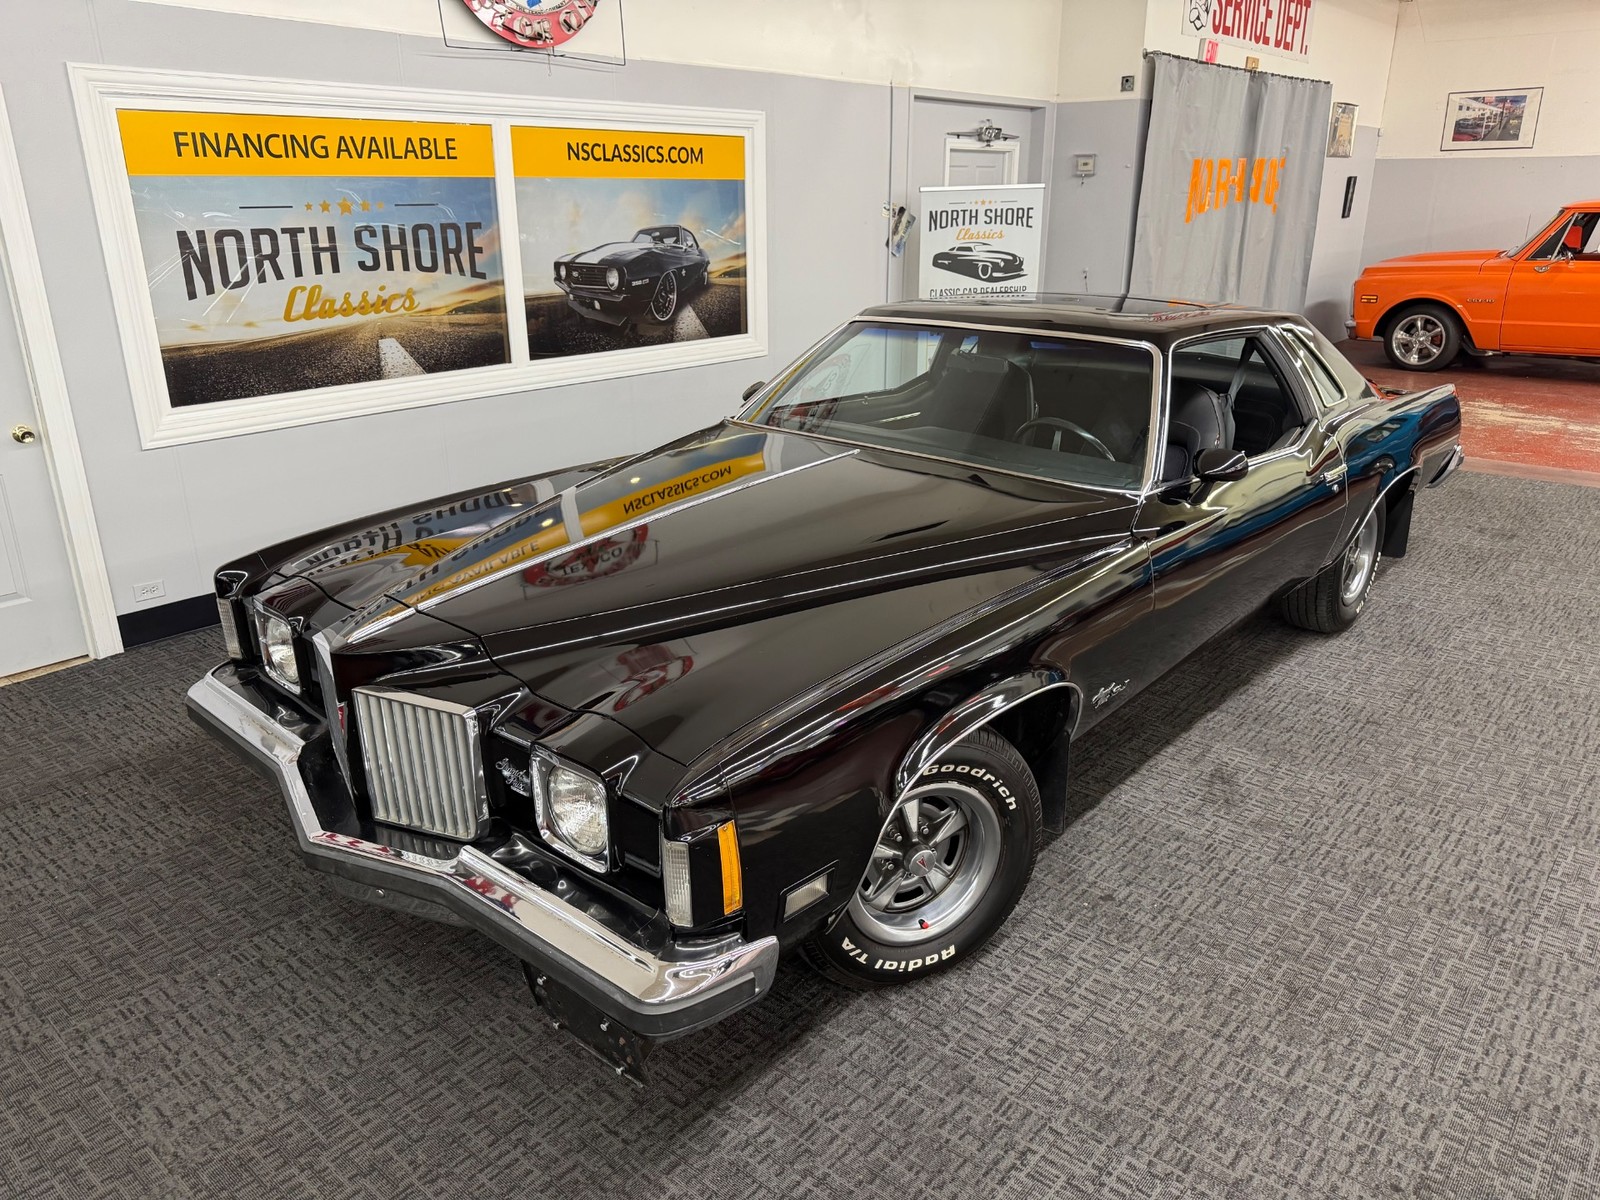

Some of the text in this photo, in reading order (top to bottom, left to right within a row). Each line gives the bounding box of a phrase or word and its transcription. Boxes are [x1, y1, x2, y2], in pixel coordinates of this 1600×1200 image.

[1212, 0, 1312, 55] SERVICE DEPT.
[173, 131, 458, 160] FINANCING AVAILABLE
[567, 142, 704, 164] NSCLASSICS.COM
[929, 207, 1034, 232] NORTH SHORE
[956, 228, 1005, 241] Classics
[176, 221, 487, 301] NORTH SHORE
[283, 284, 420, 322] Classics
[923, 763, 1017, 811] Goodrich
[841, 936, 956, 972] Radial T/A
